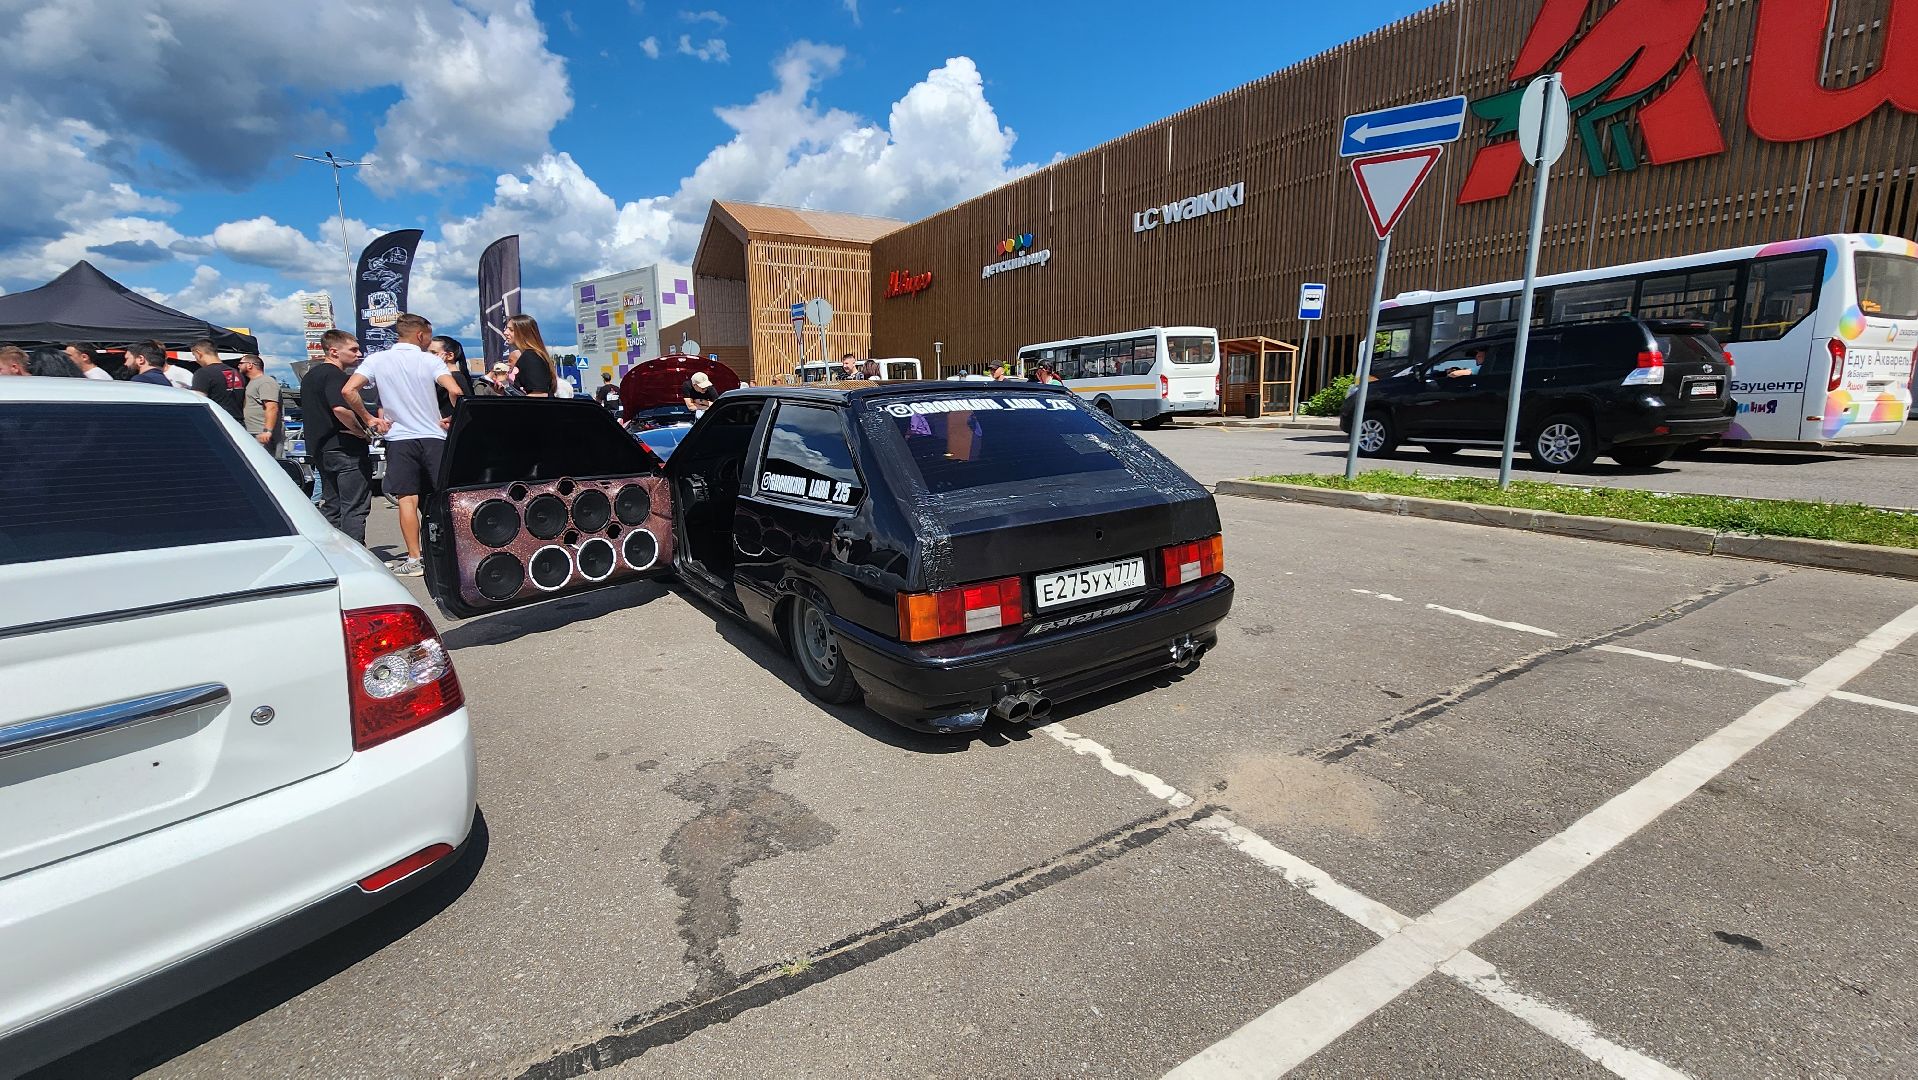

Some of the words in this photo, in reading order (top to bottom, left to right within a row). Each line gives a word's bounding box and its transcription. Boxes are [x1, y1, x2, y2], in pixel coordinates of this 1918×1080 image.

[1133, 207, 1158, 233] LC
[1847, 350, 1866, 369] Еду
[1867, 355, 1873, 366] в
[1730, 380, 1804, 394] Бауцентр
[1114, 561, 1139, 582] 777
